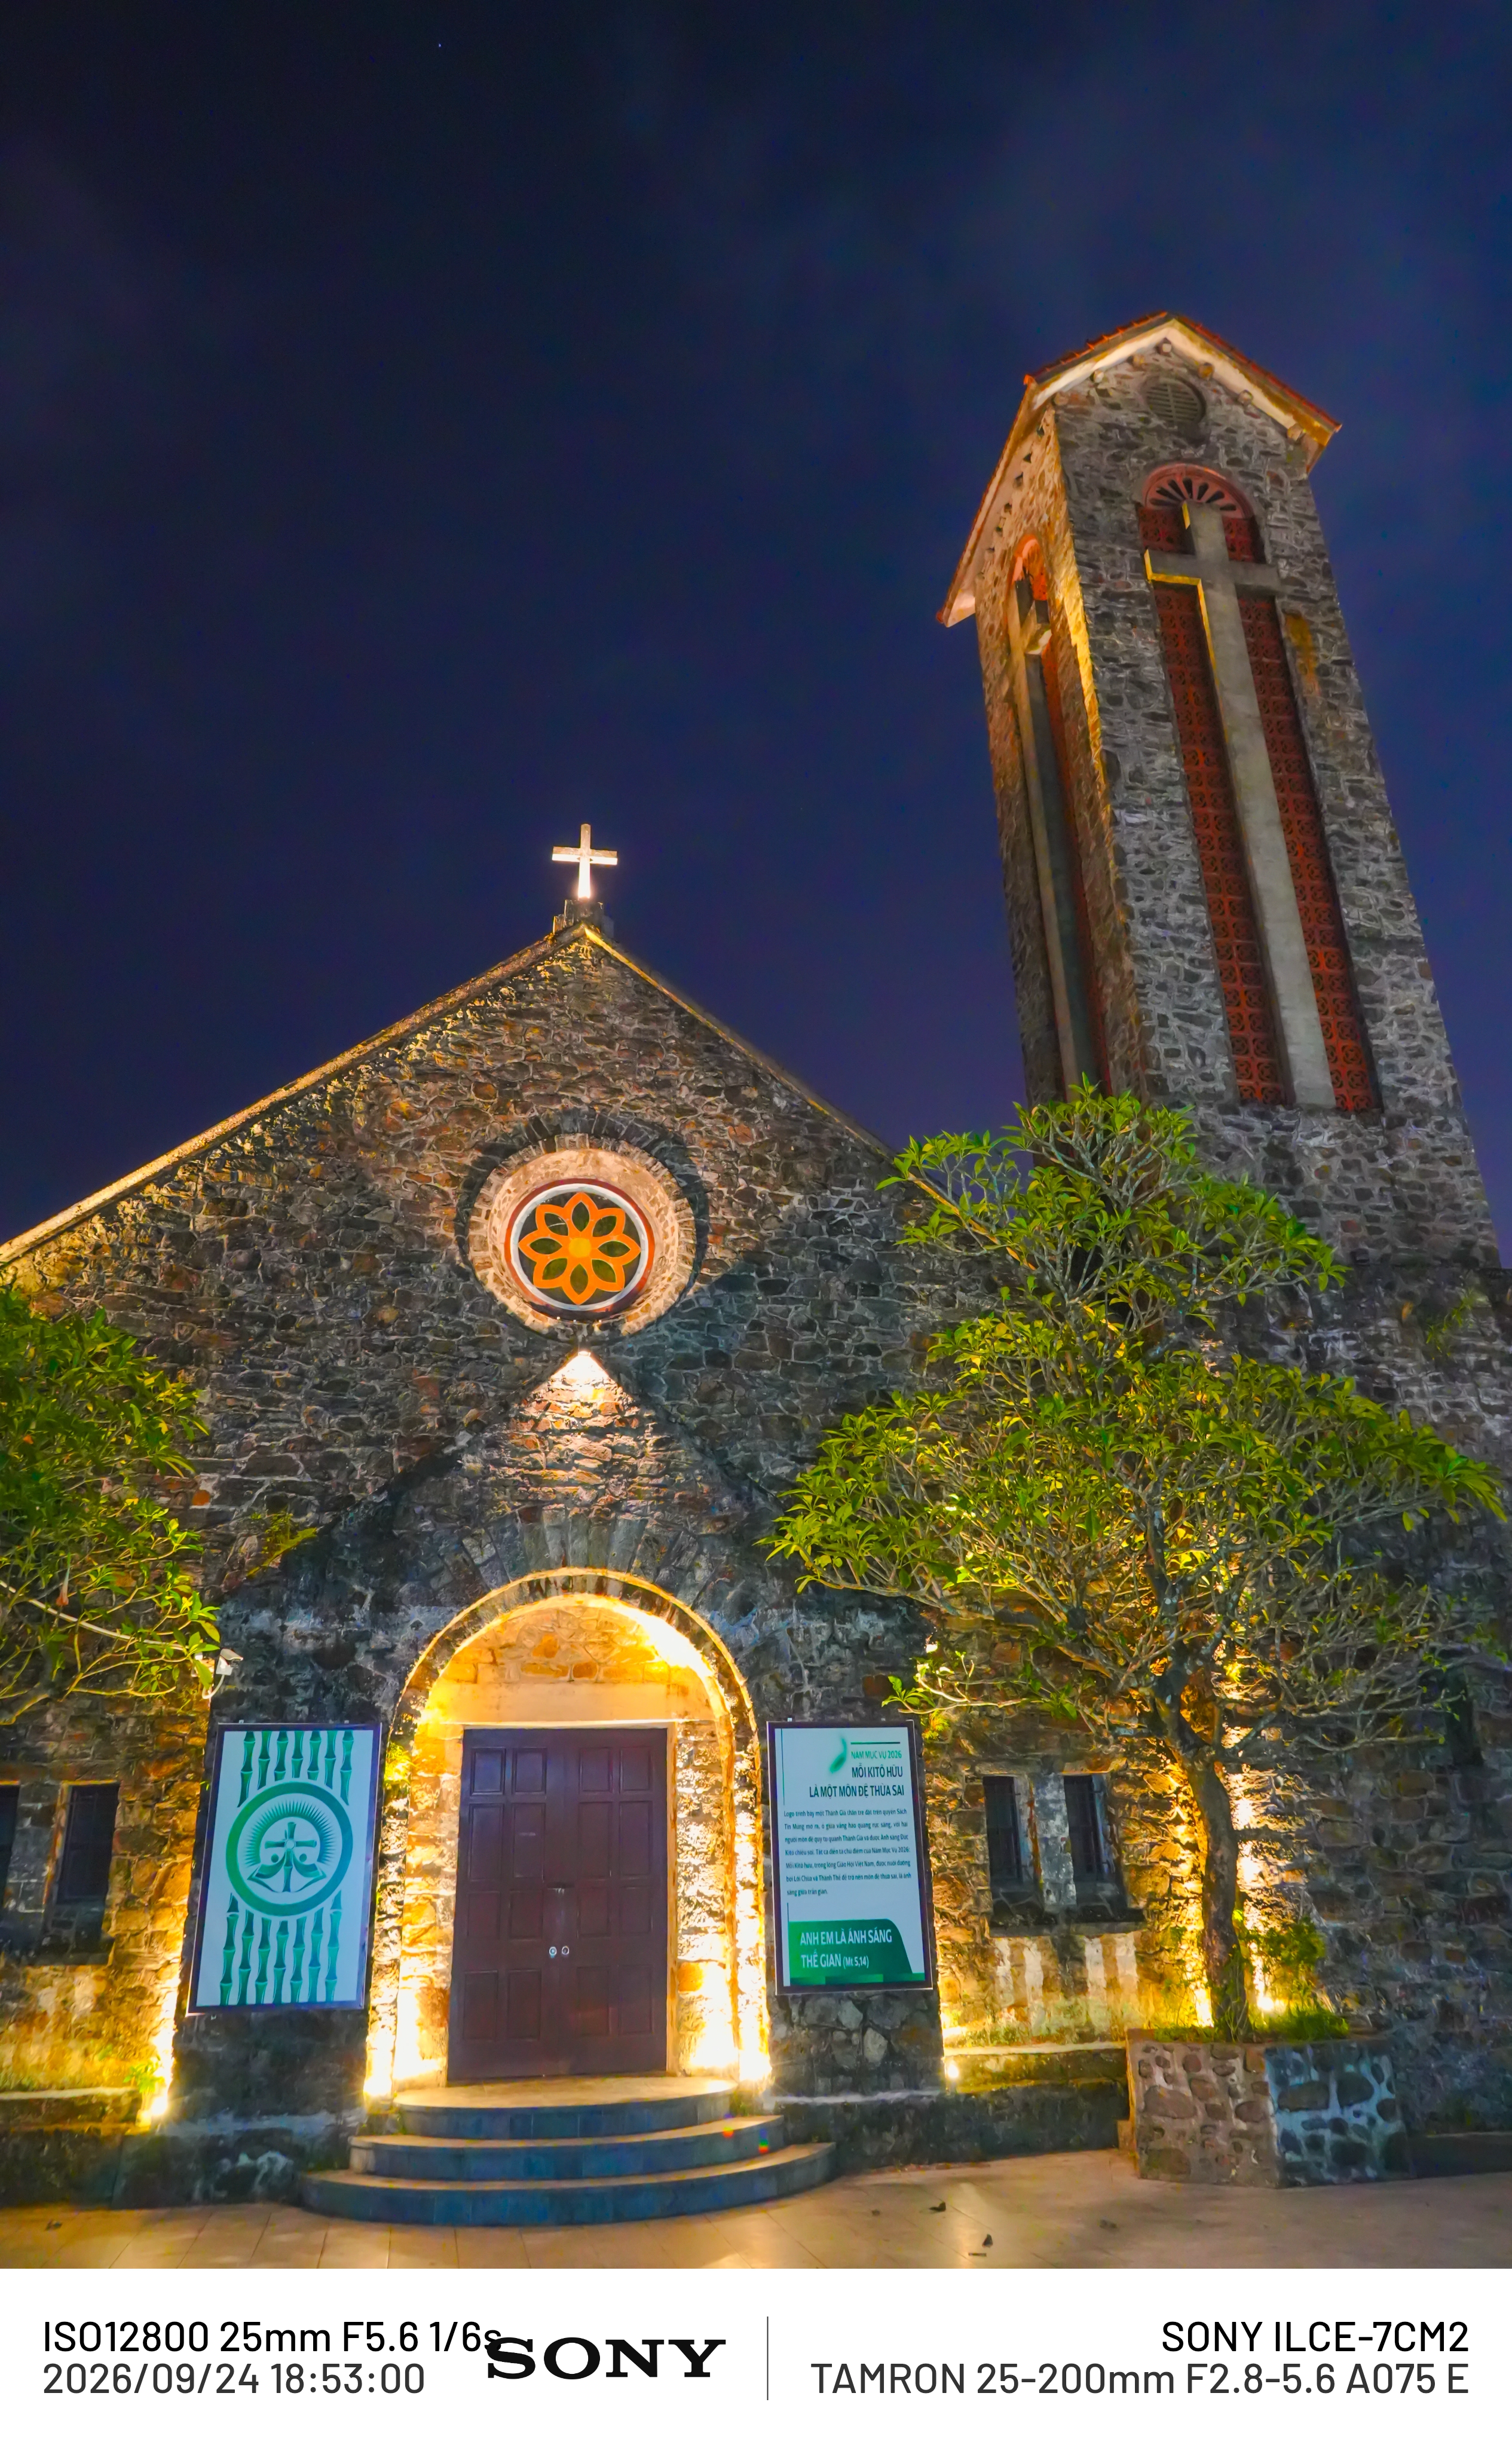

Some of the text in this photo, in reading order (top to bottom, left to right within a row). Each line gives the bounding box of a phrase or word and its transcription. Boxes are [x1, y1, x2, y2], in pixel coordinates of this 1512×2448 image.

[887, 1750, 902, 1758] 2026
[852, 1762, 903, 1778] MỖI KITÔ HỮU
[809, 1783, 819, 1798] LÀ
[820, 1783, 837, 1800] MỘT
[838, 1783, 857, 1797] MÔN
[858, 1783, 869, 1798] ĐỆ
[892, 1785, 904, 1796] SAI
[800, 1926, 892, 1945] ANH EM LÀ ÁNH SÁNG
[801, 1948, 869, 1970] THẾ GIAN (Mt 5,14)
